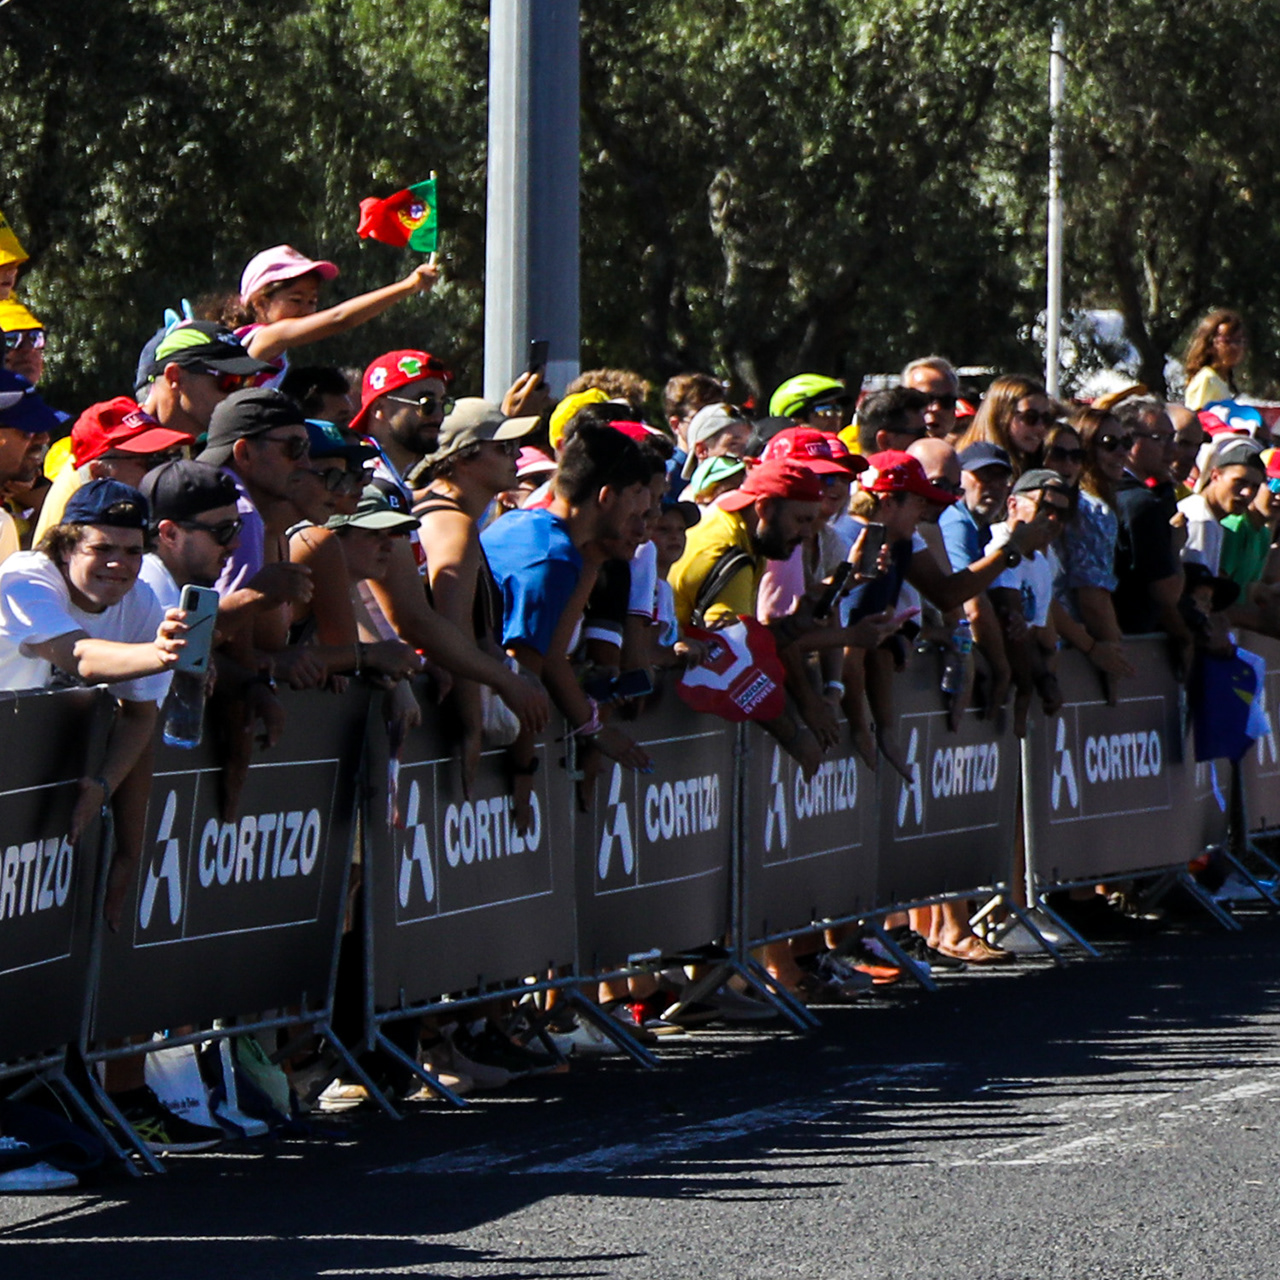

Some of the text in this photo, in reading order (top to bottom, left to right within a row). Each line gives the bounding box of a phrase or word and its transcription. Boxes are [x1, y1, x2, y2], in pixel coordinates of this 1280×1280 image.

[931, 741, 999, 799] CORTIZO
[1085, 730, 1161, 784] CORTIZO
[645, 774, 720, 843] CORTIZO
[0, 833, 73, 921] RTIZO
[199, 808, 321, 888] CORTIZO
